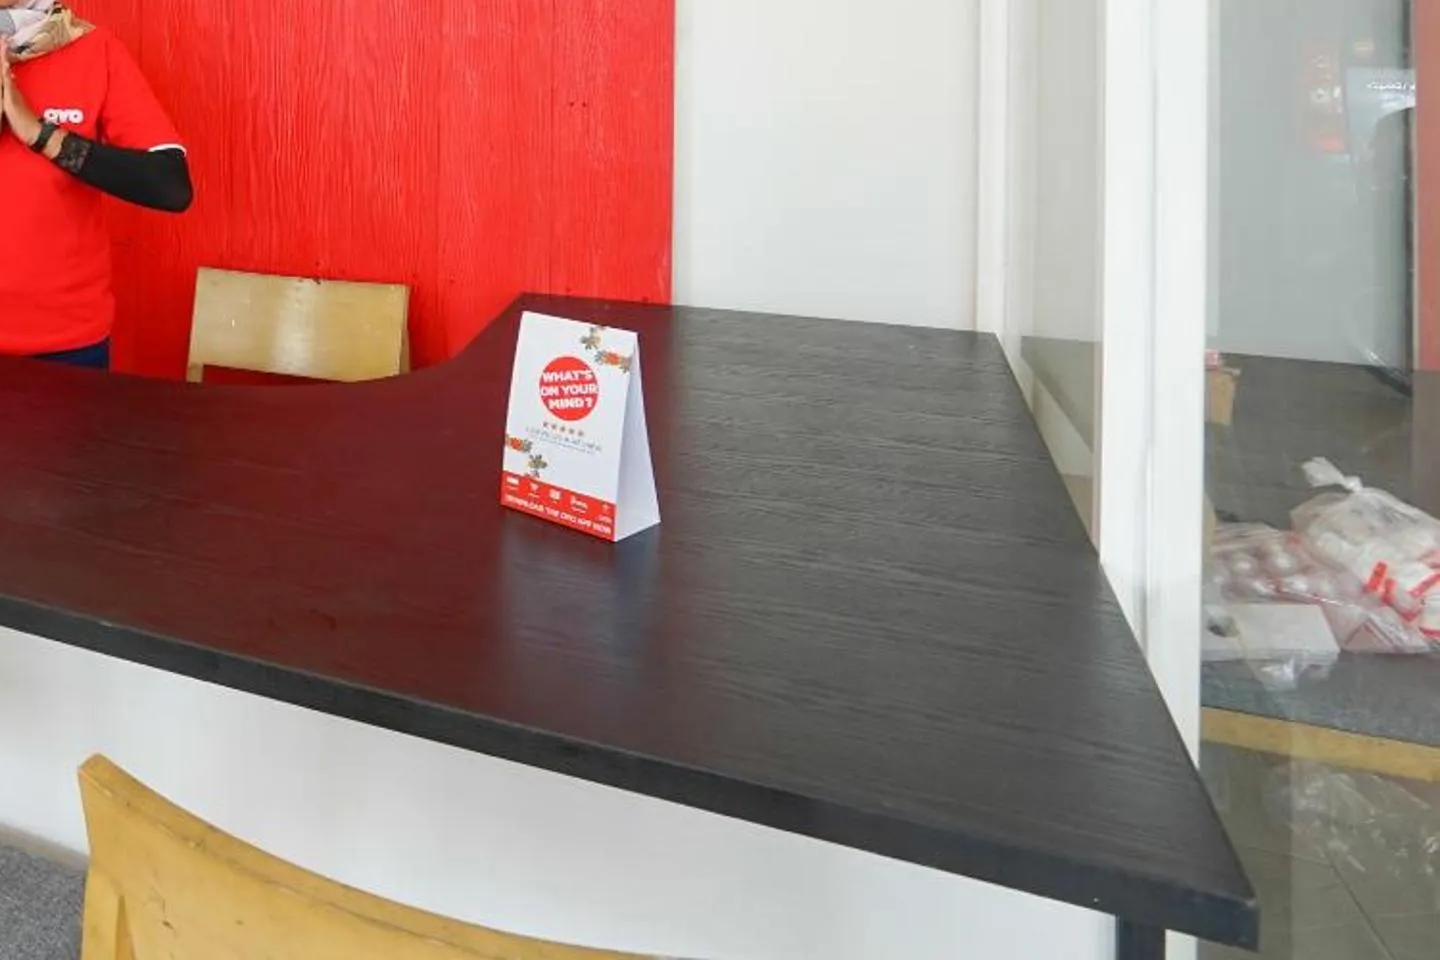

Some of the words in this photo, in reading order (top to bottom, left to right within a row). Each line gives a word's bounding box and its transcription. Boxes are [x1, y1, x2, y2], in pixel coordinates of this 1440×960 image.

[43, 108, 84, 126] OYO
[542, 369, 594, 382] WHAT'S
[540, 385, 559, 397] ON
[561, 382, 599, 396] YOUR
